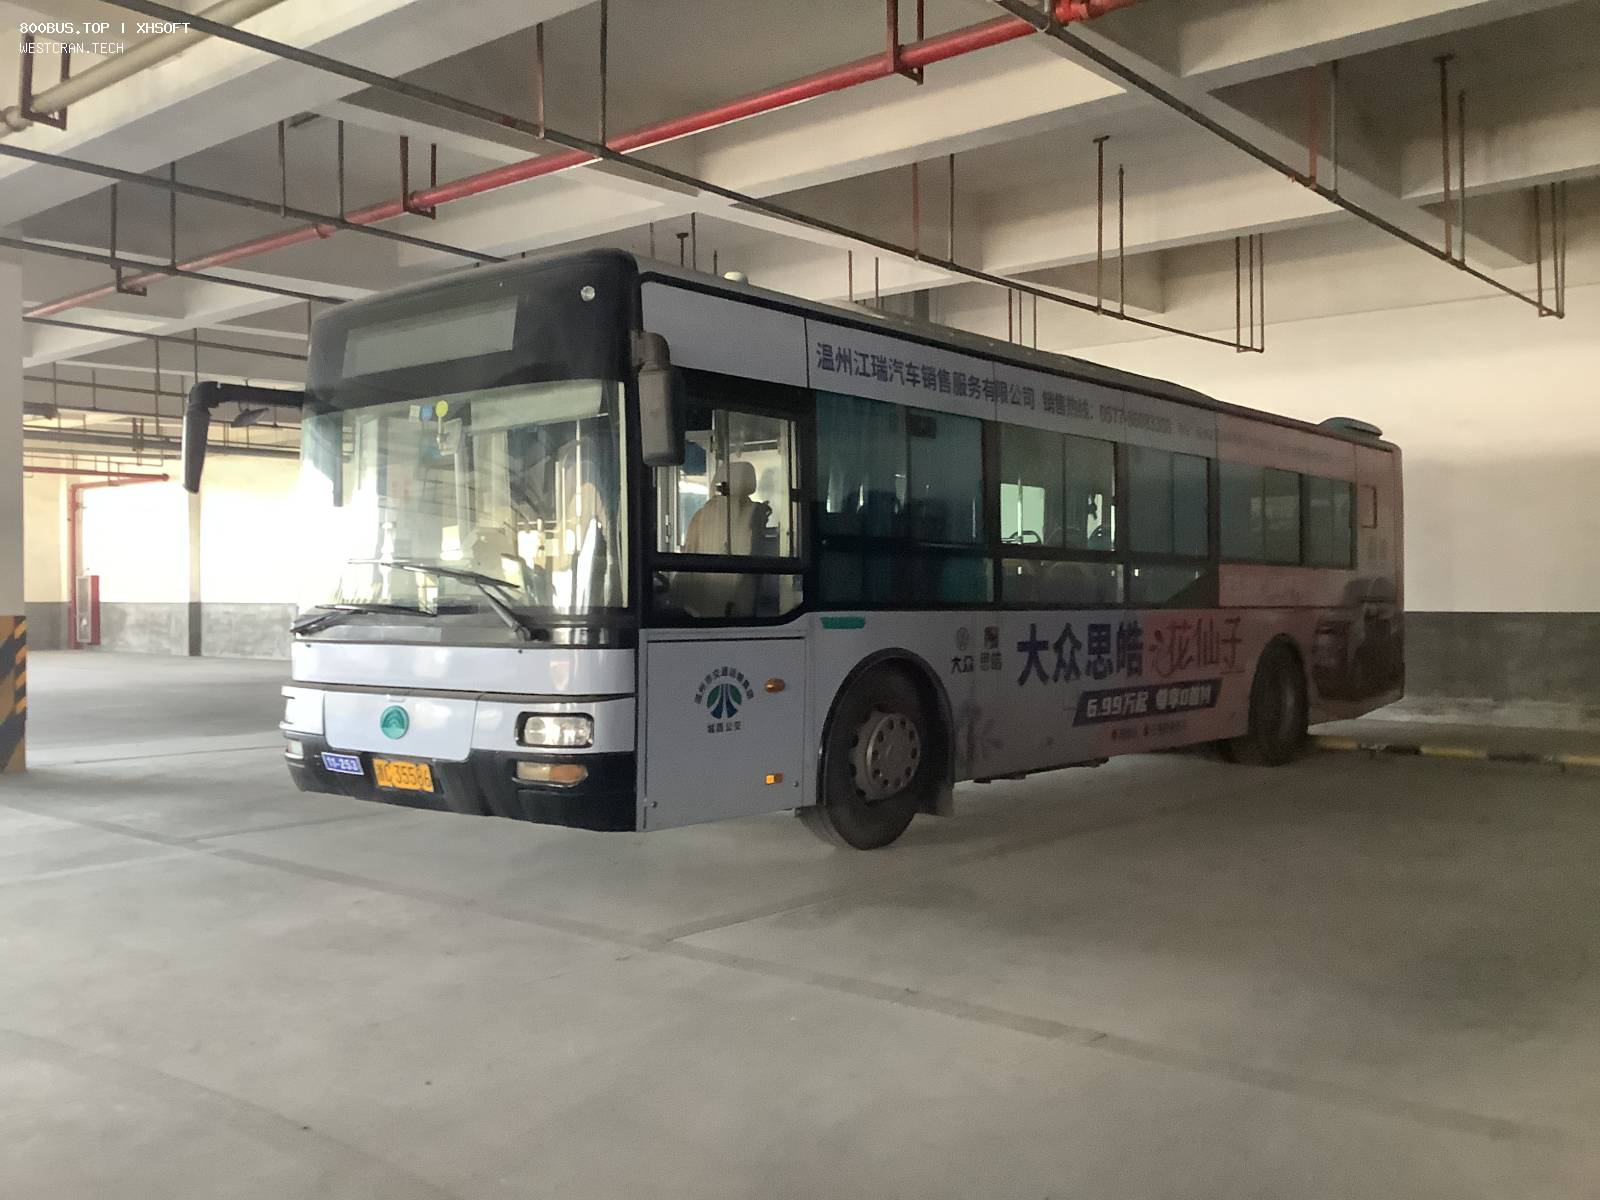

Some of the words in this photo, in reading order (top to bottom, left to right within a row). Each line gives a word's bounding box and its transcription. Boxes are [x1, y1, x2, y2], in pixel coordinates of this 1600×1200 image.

[816, 342, 1036, 410] 温州江瑞汽车销售服务有限公司
[951, 655, 975, 674] 大众
[1016, 621, 1144, 687] 大众思皓
